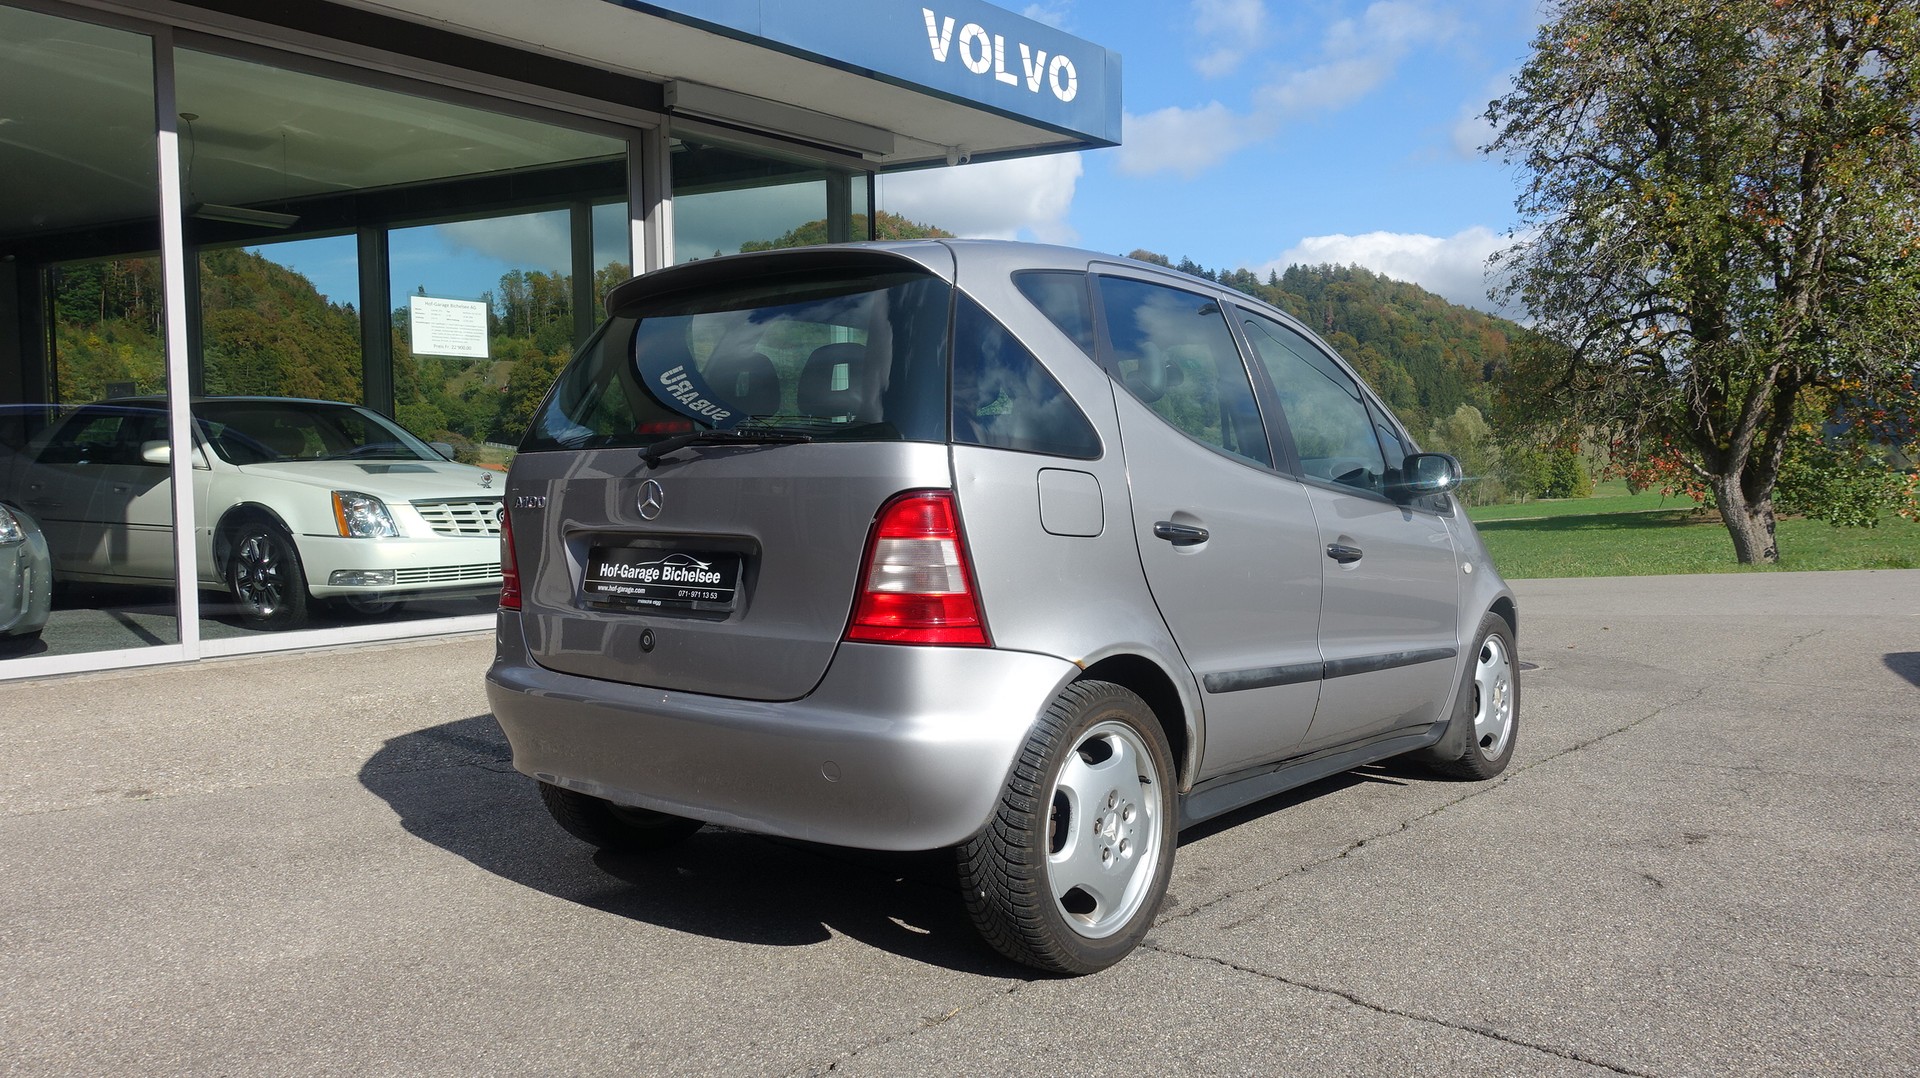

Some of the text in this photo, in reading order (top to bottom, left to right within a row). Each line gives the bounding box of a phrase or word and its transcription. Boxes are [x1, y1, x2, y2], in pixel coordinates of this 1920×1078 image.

[922, 7, 1077, 102] VOLVO
[600, 563, 720, 584] Hof-Garage Bichelsee
[598, 585, 645, 594] www.hof-garage.com
[703, 591, 710, 599] 13
